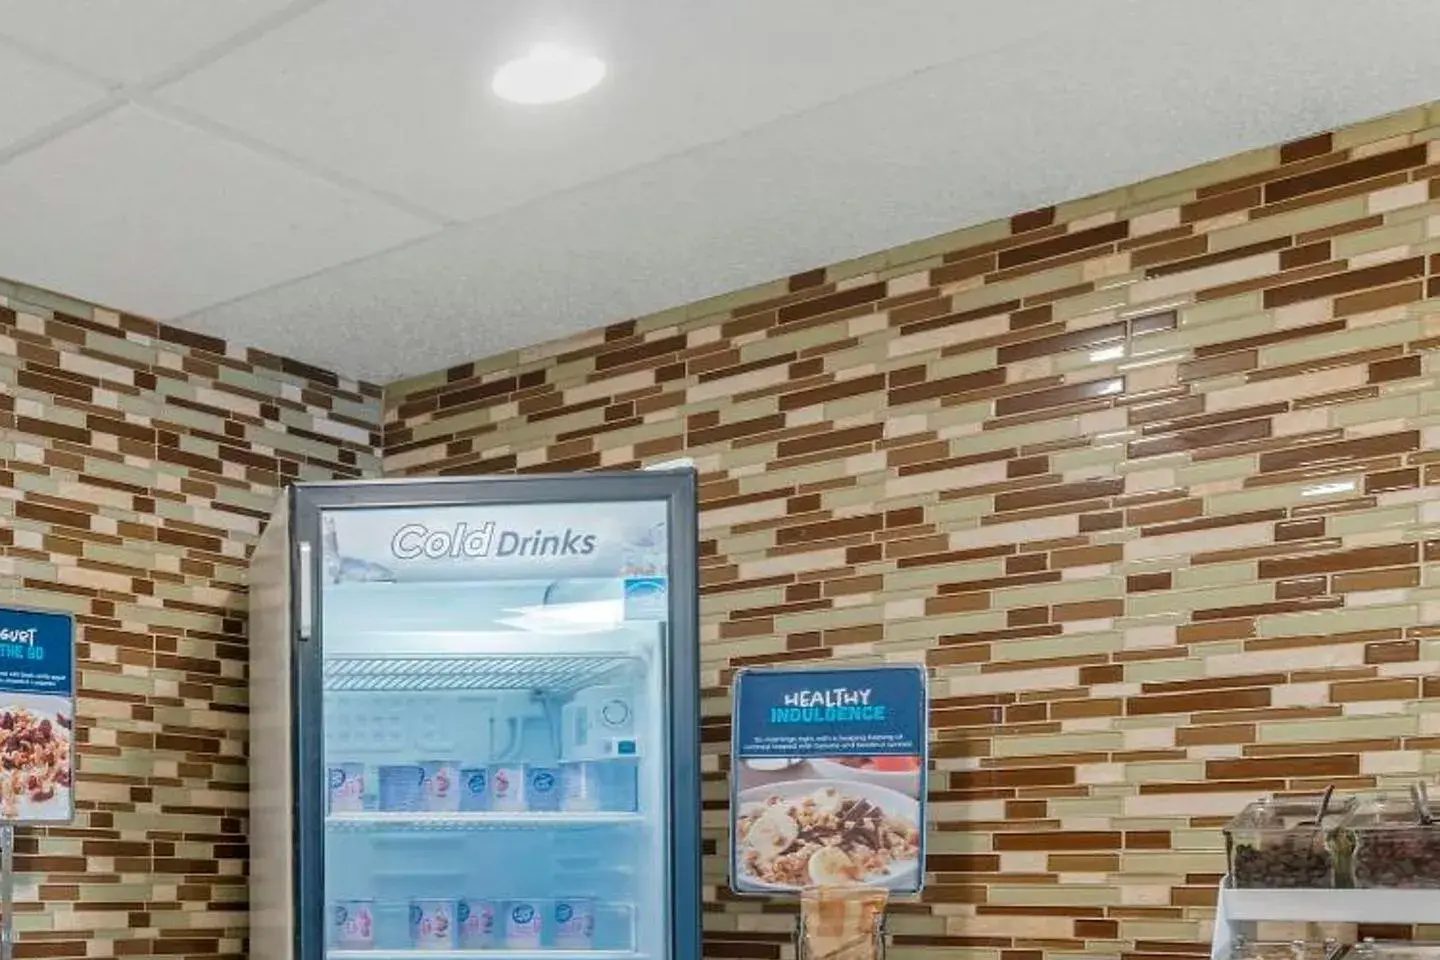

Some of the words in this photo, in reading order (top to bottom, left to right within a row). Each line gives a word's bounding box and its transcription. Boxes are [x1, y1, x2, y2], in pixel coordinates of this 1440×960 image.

[391, 521, 495, 559] Cold
[497, 529, 597, 557] Drinks
[784, 689, 872, 707] HEALTHY
[771, 705, 885, 723] INDULGENCE
